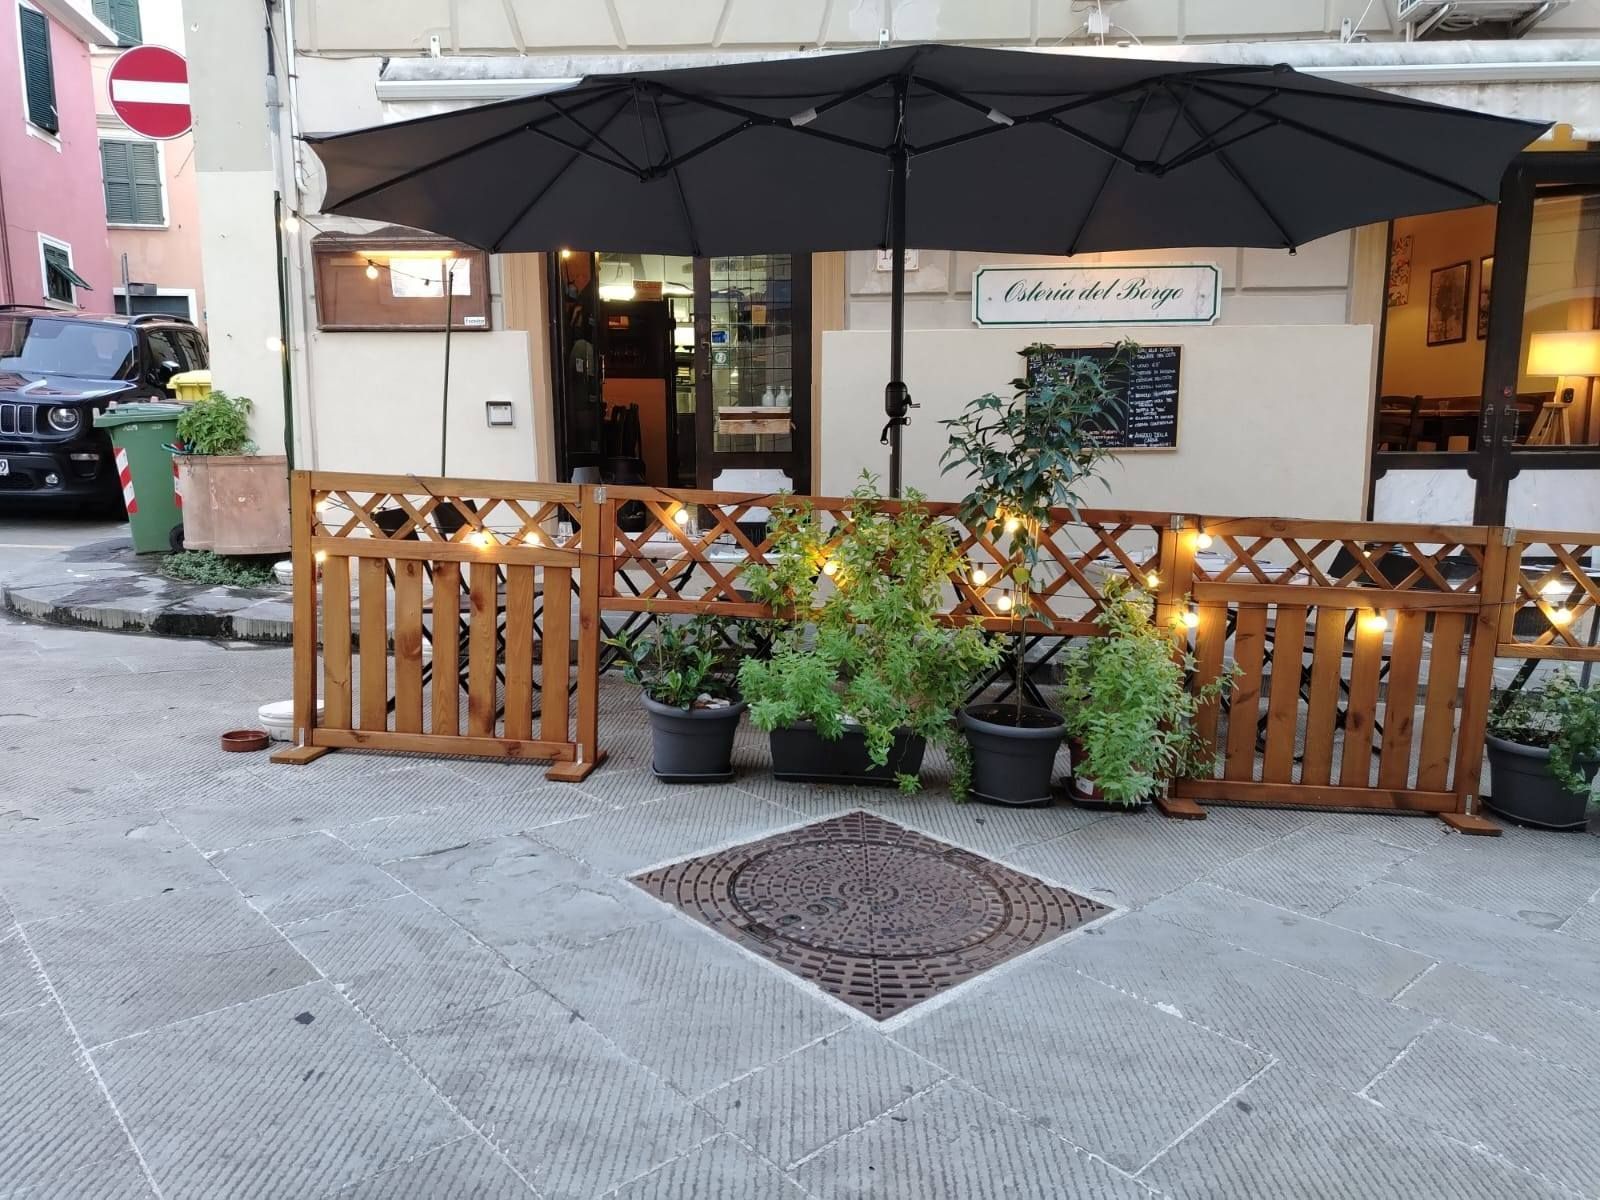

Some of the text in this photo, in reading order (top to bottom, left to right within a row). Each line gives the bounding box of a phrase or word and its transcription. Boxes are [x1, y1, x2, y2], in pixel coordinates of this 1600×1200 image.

[1004, 277, 1184, 310] Osteria del Borgo
